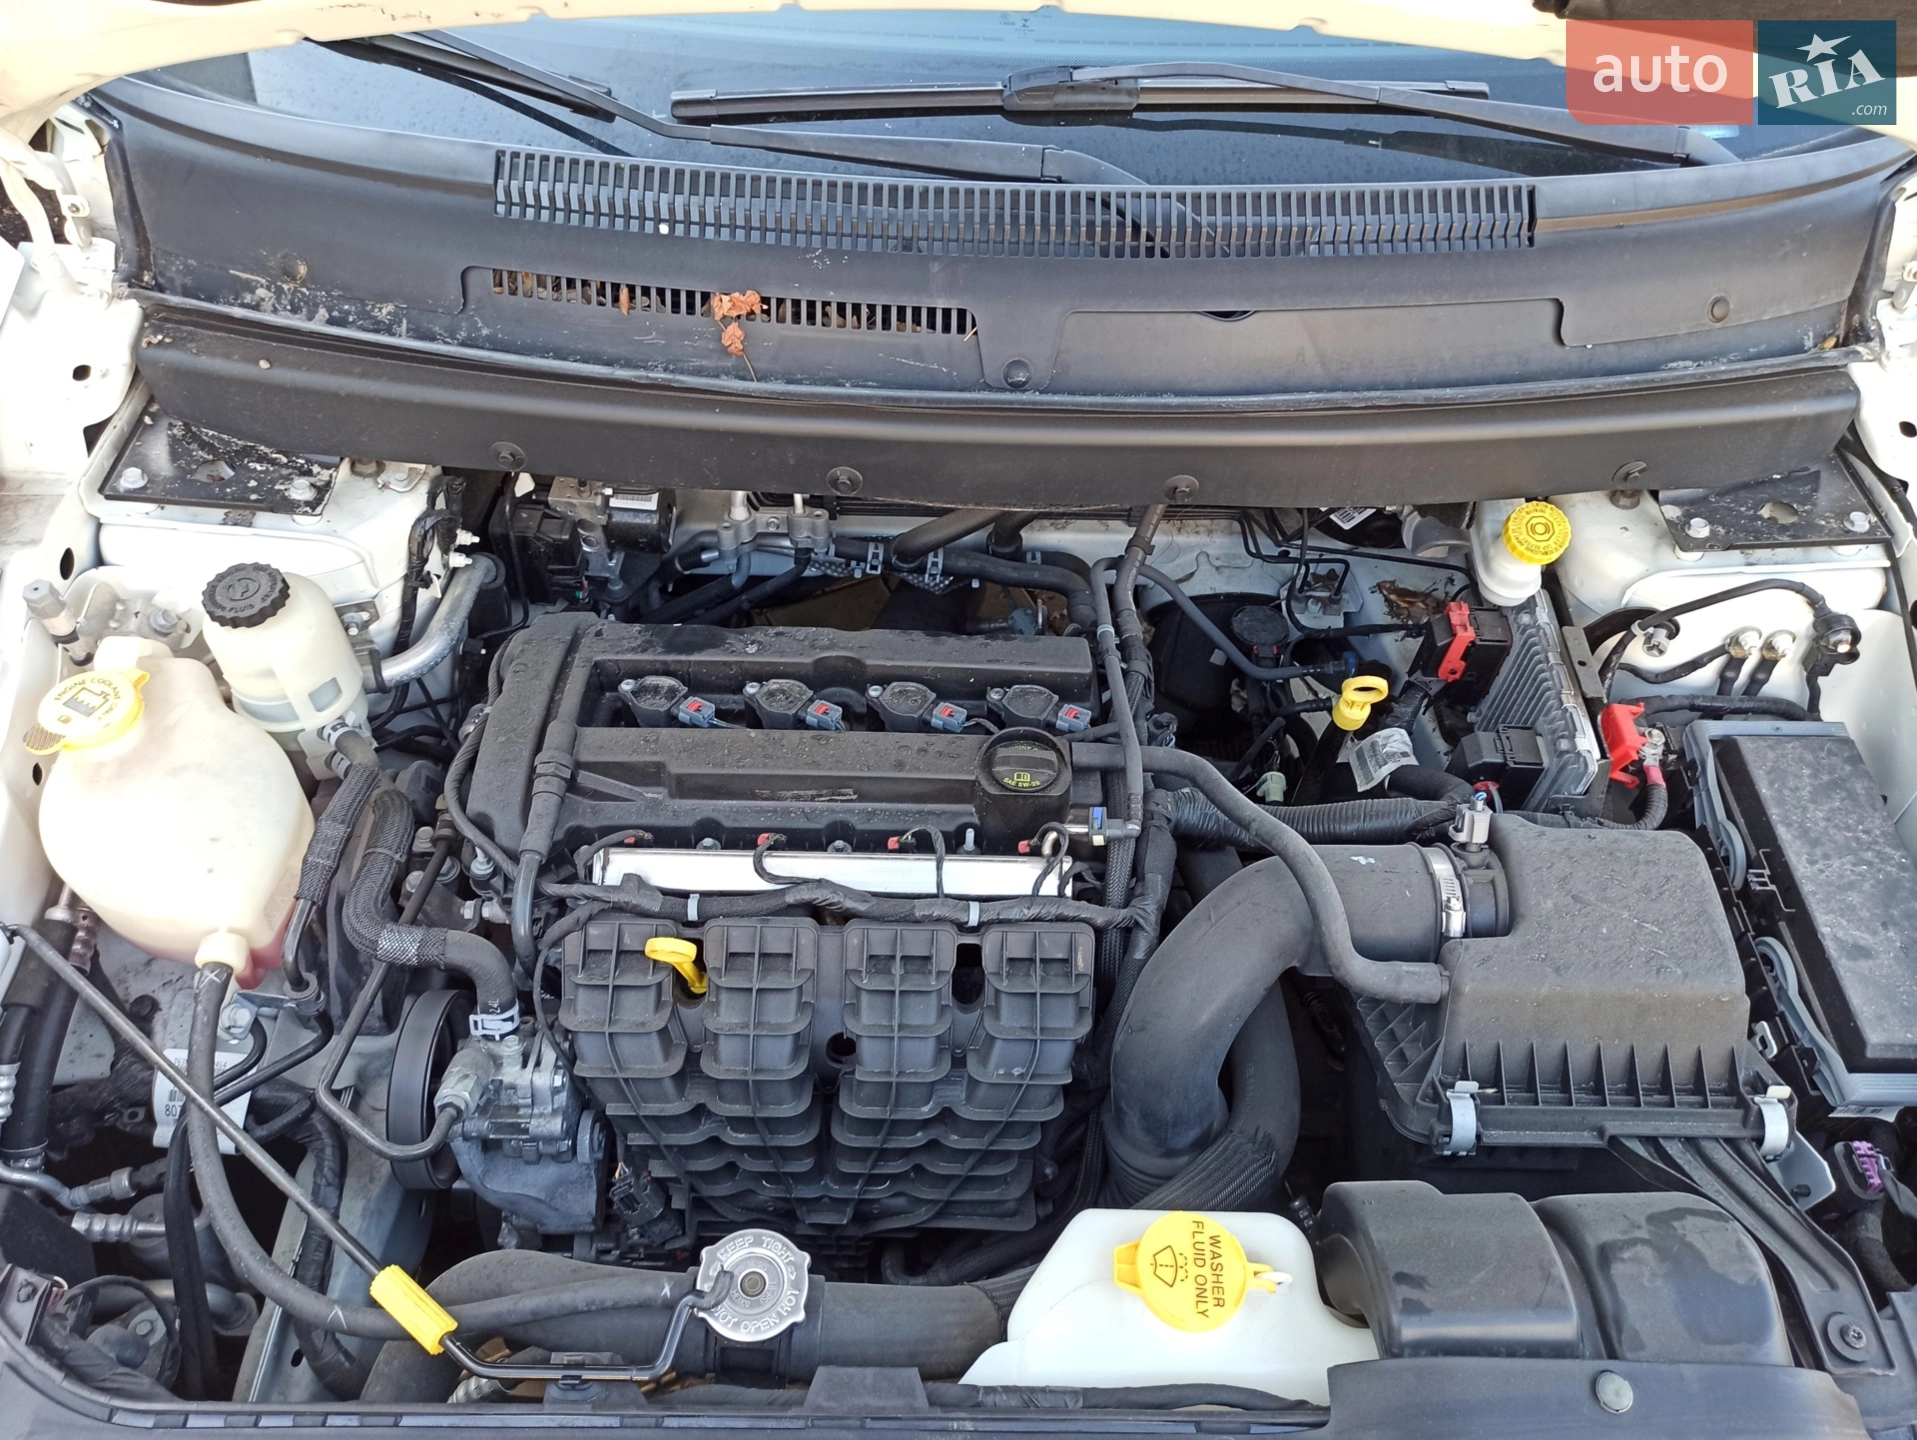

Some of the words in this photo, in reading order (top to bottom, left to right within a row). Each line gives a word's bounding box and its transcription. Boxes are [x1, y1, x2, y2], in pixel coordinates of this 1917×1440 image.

[90, 677, 121, 700] COOLANT
[1003, 777, 1017, 786] SAE
[717, 1235, 754, 1261] KEEP
[761, 1236, 795, 1263] TIGHT
[1192, 1220, 1206, 1268] FLUID
[1209, 1234, 1225, 1308] WASHER
[740, 1314, 780, 1333] OPEN
[778, 1287, 800, 1316] HOT
[1194, 1274, 1209, 1319] ONLY
